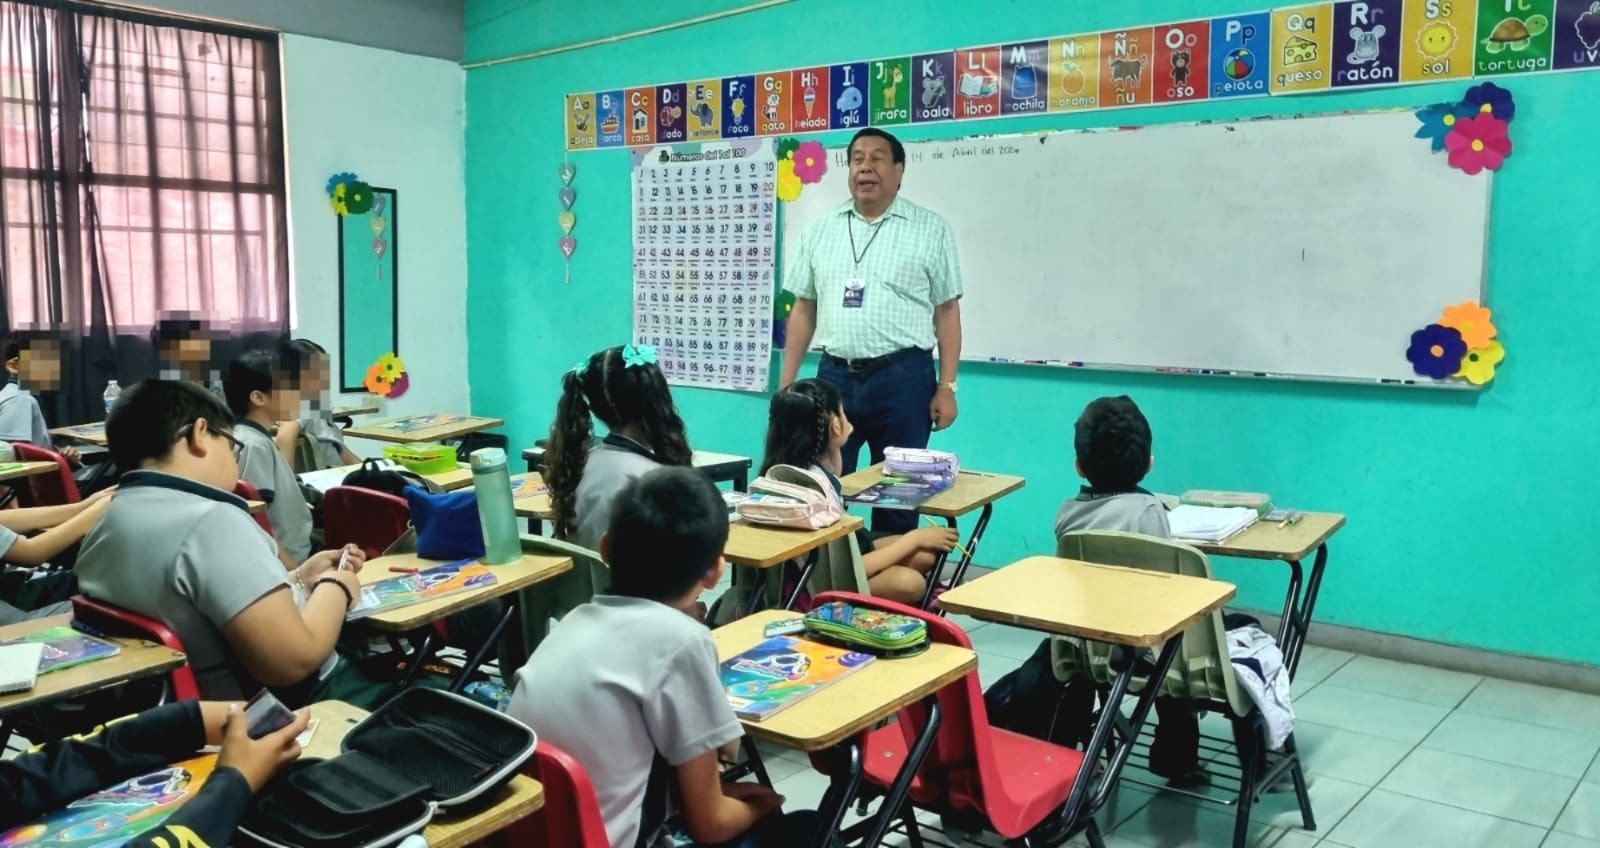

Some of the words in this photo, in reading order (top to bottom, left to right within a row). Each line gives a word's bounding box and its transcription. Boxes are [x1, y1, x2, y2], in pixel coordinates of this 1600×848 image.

[1351, 2, 1384, 25] Rr
[1425, 0, 1452, 19] Ss
[1287, 14, 1316, 33] Qq
[1165, 29, 1197, 48] Oo
[1226, 20, 1256, 46] Pp
[1062, 41, 1086, 58] Nn
[1115, 32, 1138, 56] Ññ
[969, 52, 985, 70] Ll
[1479, 57, 1546, 71] tortuga
[1574, 50, 1600, 63] uv
[876, 63, 888, 83] Jj
[922, 59, 943, 77] Kk
[1338, 63, 1393, 82] ratón
[1422, 59, 1449, 74] sol
[802, 72, 819, 87] Hh
[843, 66, 855, 86] Ii
[1277, 69, 1323, 87] queso
[696, 83, 713, 99] Ee
[730, 82, 746, 97] Ff
[764, 77, 783, 93] Gg
[1167, 86, 1194, 97] oso
[1215, 80, 1263, 96] pelota
[631, 92, 649, 106] Cc
[663, 88, 680, 104] Dd
[1117, 89, 1135, 104] ñu
[874, 108, 907, 124] jirafa
[916, 106, 950, 119] koala
[964, 103, 992, 115] libro
[795, 117, 827, 129] helado
[840, 110, 860, 127] iglú
[662, 130, 682, 139] dado
[762, 123, 785, 135] gato
[765, 162, 774, 171] 10
[705, 185, 712, 194] 16
[720, 185, 727, 193] 17
[736, 184, 742, 193] 18
[751, 183, 758, 192] 19
[763, 182, 774, 191] 20
[649, 207, 657, 215] 22
[664, 207, 672, 215] 23
[720, 205, 728, 214] 27
[734, 204, 743, 213] 28
[639, 225, 646, 234] 31
[648, 225, 657, 234] 32
[662, 225, 671, 234] 33
[676, 225, 686, 234] 34
[692, 225, 701, 234] 35
[706, 225, 715, 234] 36
[720, 224, 729, 233] 37
[734, 224, 743, 233] 38
[747, 223, 757, 232] 39
[638, 248, 646, 257] 41
[661, 248, 671, 257] 43
[675, 248, 685, 257] 44
[690, 248, 700, 257] 45
[705, 248, 714, 257] 46
[720, 248, 729, 257] 47
[747, 248, 758, 257] 49
[649, 271, 657, 279] 52
[661, 271, 670, 279] 53
[676, 271, 685, 280] 54
[690, 271, 699, 280] 55
[705, 272, 714, 280] 56
[720, 272, 728, 280] 57
[732, 272, 742, 280] 58
[748, 272, 758, 280] 59
[675, 294, 684, 302] 64
[690, 295, 698, 303] 65
[704, 295, 712, 303] 66
[718, 295, 726, 304] 67
[733, 295, 743, 304] 68
[675, 317, 683, 325] 74
[689, 317, 698, 326] 75
[704, 318, 712, 327] 76
[718, 318, 727, 327] 77
[748, 319, 755, 328] 79
[689, 340, 698, 349] 85
[703, 340, 712, 349] 86
[720, 341, 728, 349] 87
[748, 342, 756, 351] 89
[664, 361, 673, 369] 93
[690, 362, 698, 371] 95
[704, 364, 714, 372] 96
[720, 365, 728, 373] 97
[733, 365, 742, 374] 98
[746, 366, 755, 375] 99
